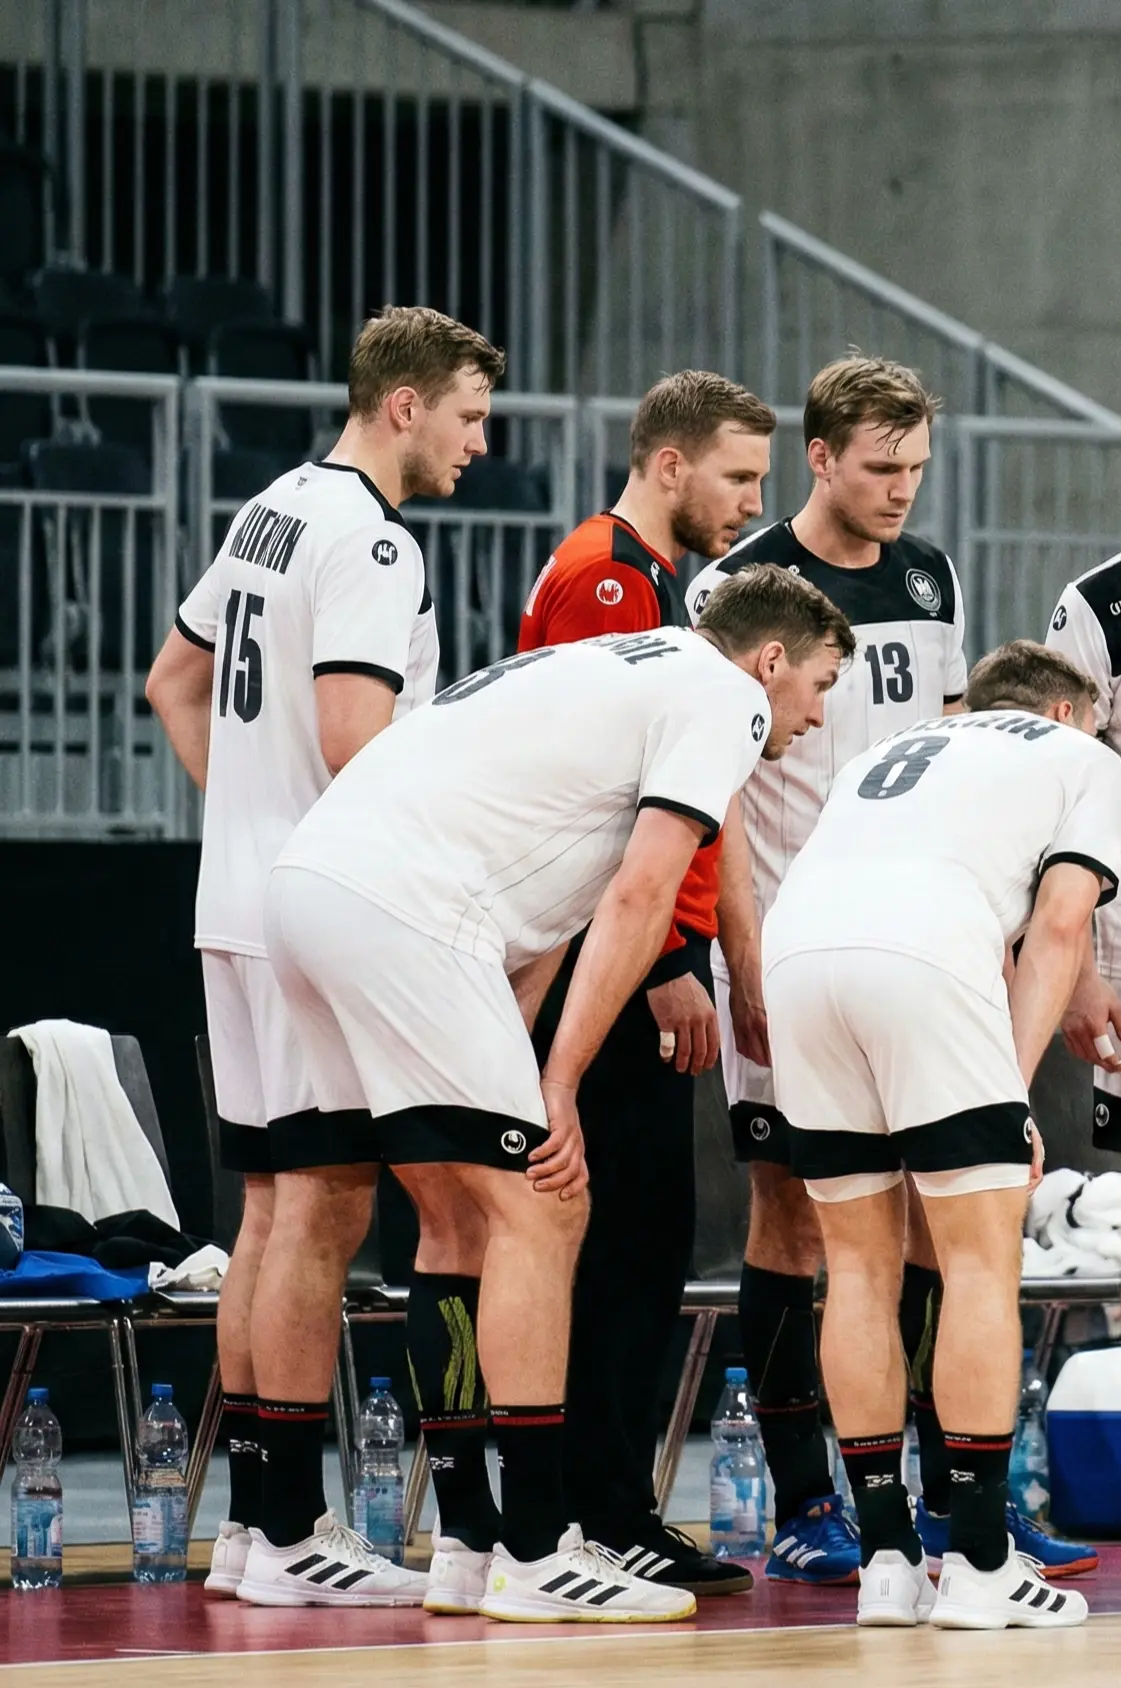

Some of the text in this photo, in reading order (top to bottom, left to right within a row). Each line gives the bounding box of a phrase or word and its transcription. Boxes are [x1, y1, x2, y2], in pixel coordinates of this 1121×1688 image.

[219, 588, 265, 724] 15
[864, 641, 914, 705] 13
[857, 735, 951, 800] 8
